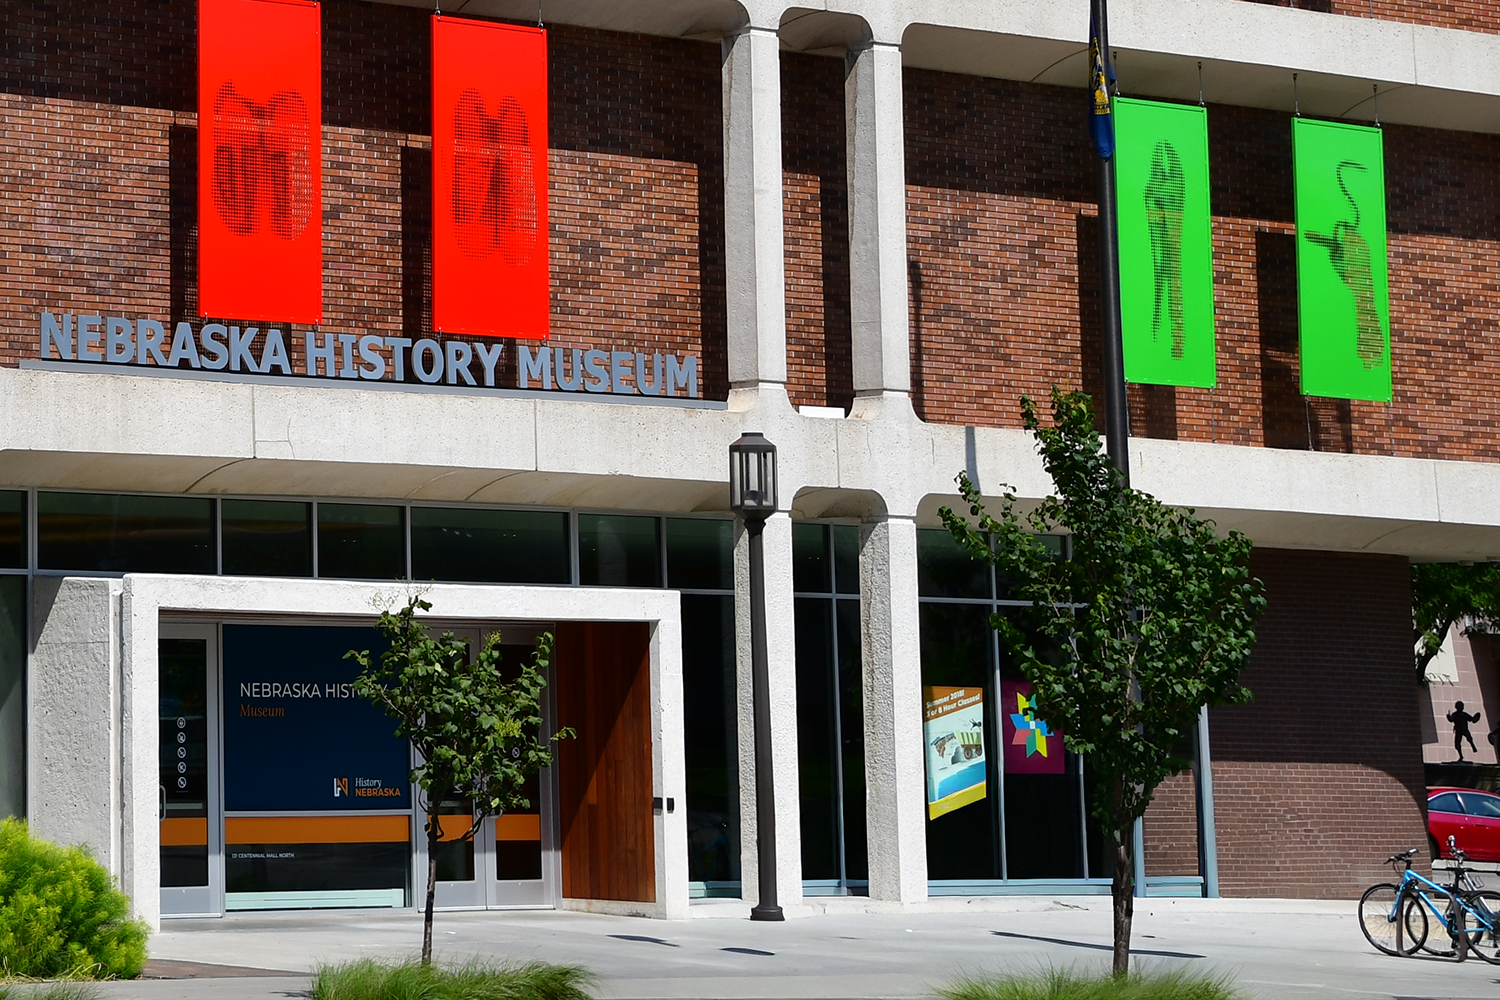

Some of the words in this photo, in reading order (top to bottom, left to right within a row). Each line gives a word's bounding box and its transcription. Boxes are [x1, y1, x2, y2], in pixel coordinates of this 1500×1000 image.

[39, 312, 292, 375] NEBRASKA
[305, 331, 504, 387] HISTORY
[517, 344, 699, 398] MUSEUM
[240, 682, 322, 699] NEBRASKA
[926, 695, 950, 709] Summer
[240, 704, 285, 717] Museum
[355, 777, 382, 789] History
[355, 787, 401, 797] NEBRASKA
